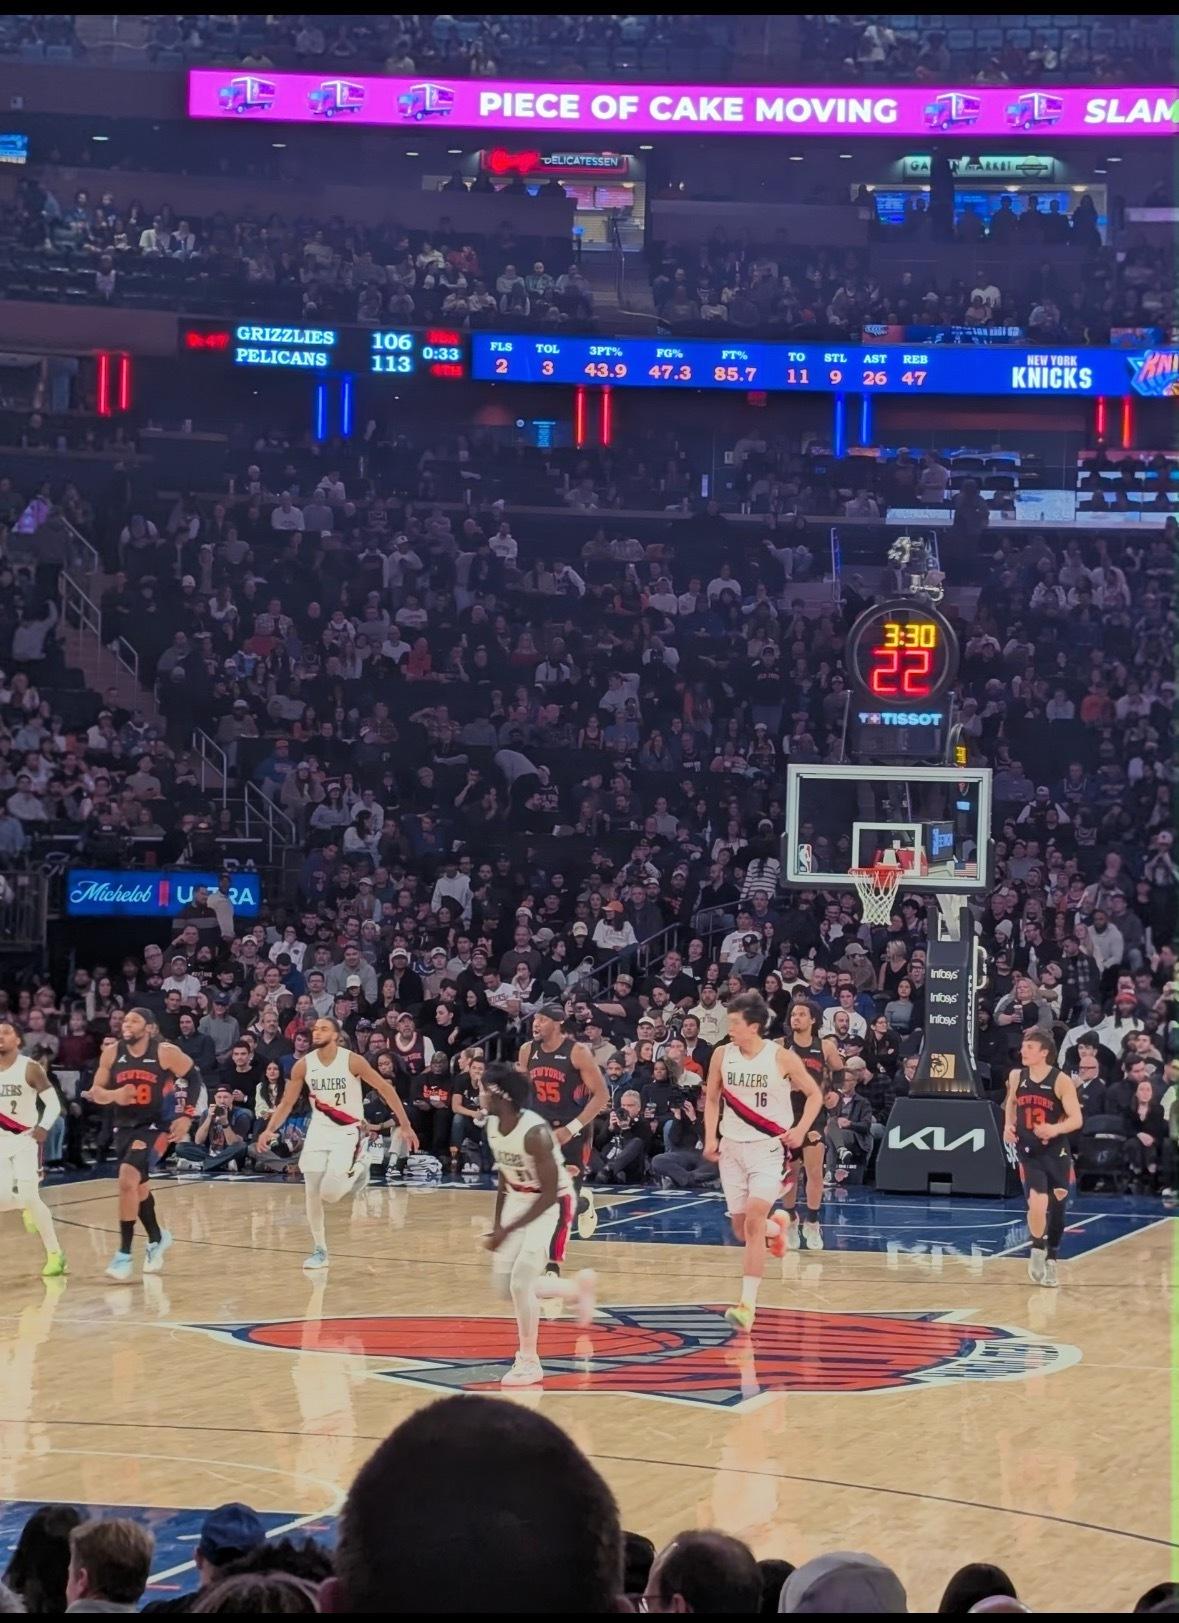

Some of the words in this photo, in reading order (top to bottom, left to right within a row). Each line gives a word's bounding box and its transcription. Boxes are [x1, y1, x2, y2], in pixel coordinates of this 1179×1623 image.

[479, 92, 580, 118] PIECE
[591, 95, 639, 120] OF
[643, 96, 744, 122] CAKE
[756, 97, 898, 124] MOVING
[544, 155, 618, 166] DELICATESSEN
[236, 326, 335, 345] GRIZZLIES
[372, 332, 412, 350] 106
[235, 348, 328, 367] PELICANS
[372, 355, 411, 373] 113
[422, 346, 460, 361] 0:33
[490, 342, 512, 352] FLS
[536, 344, 560, 354] TOL
[589, 346, 623, 357] 3PT%
[656, 348, 683, 359] FG%
[722, 350, 748, 360] FT%
[788, 352, 806, 362] TO
[824, 353, 847, 363] STL
[863, 354, 888, 364] AST
[903, 355, 928, 365] REB
[1027, 355, 1049, 366] NEW
[1051, 355, 1078, 366] YORK
[495, 358, 508, 373] 2
[542, 360, 554, 375] 3
[585, 363, 627, 378] 43.9
[648, 364, 692, 380] 47.3
[714, 366, 757, 381] 85.7
[787, 369, 809, 384] 11
[829, 370, 842, 385] 9
[862, 370, 887, 386] 26
[901, 371, 927, 386] 47
[1012, 366, 1093, 389] KNICKS
[884, 624, 936, 648] 3:30
[872, 650, 930, 693] 22
[881, 712, 943, 726] TISSOT
[70, 880, 153, 904] Michelob
[930, 969, 959, 980] Infosys
[930, 993, 958, 1004] Infosys
[929, 1014, 958, 1026] Infosys
[311, 1077, 347, 1091] BLAZERS
[727, 1072, 768, 1088] BLAZERS
[334, 1092, 346, 1106] 21
[534, 1080, 560, 1103] 55
[755, 1091, 767, 1108] 16
[10, 1100, 18, 1115] 2
[1024, 1107, 1046, 1129] 13
[888, 1125, 985, 1152] KIA
